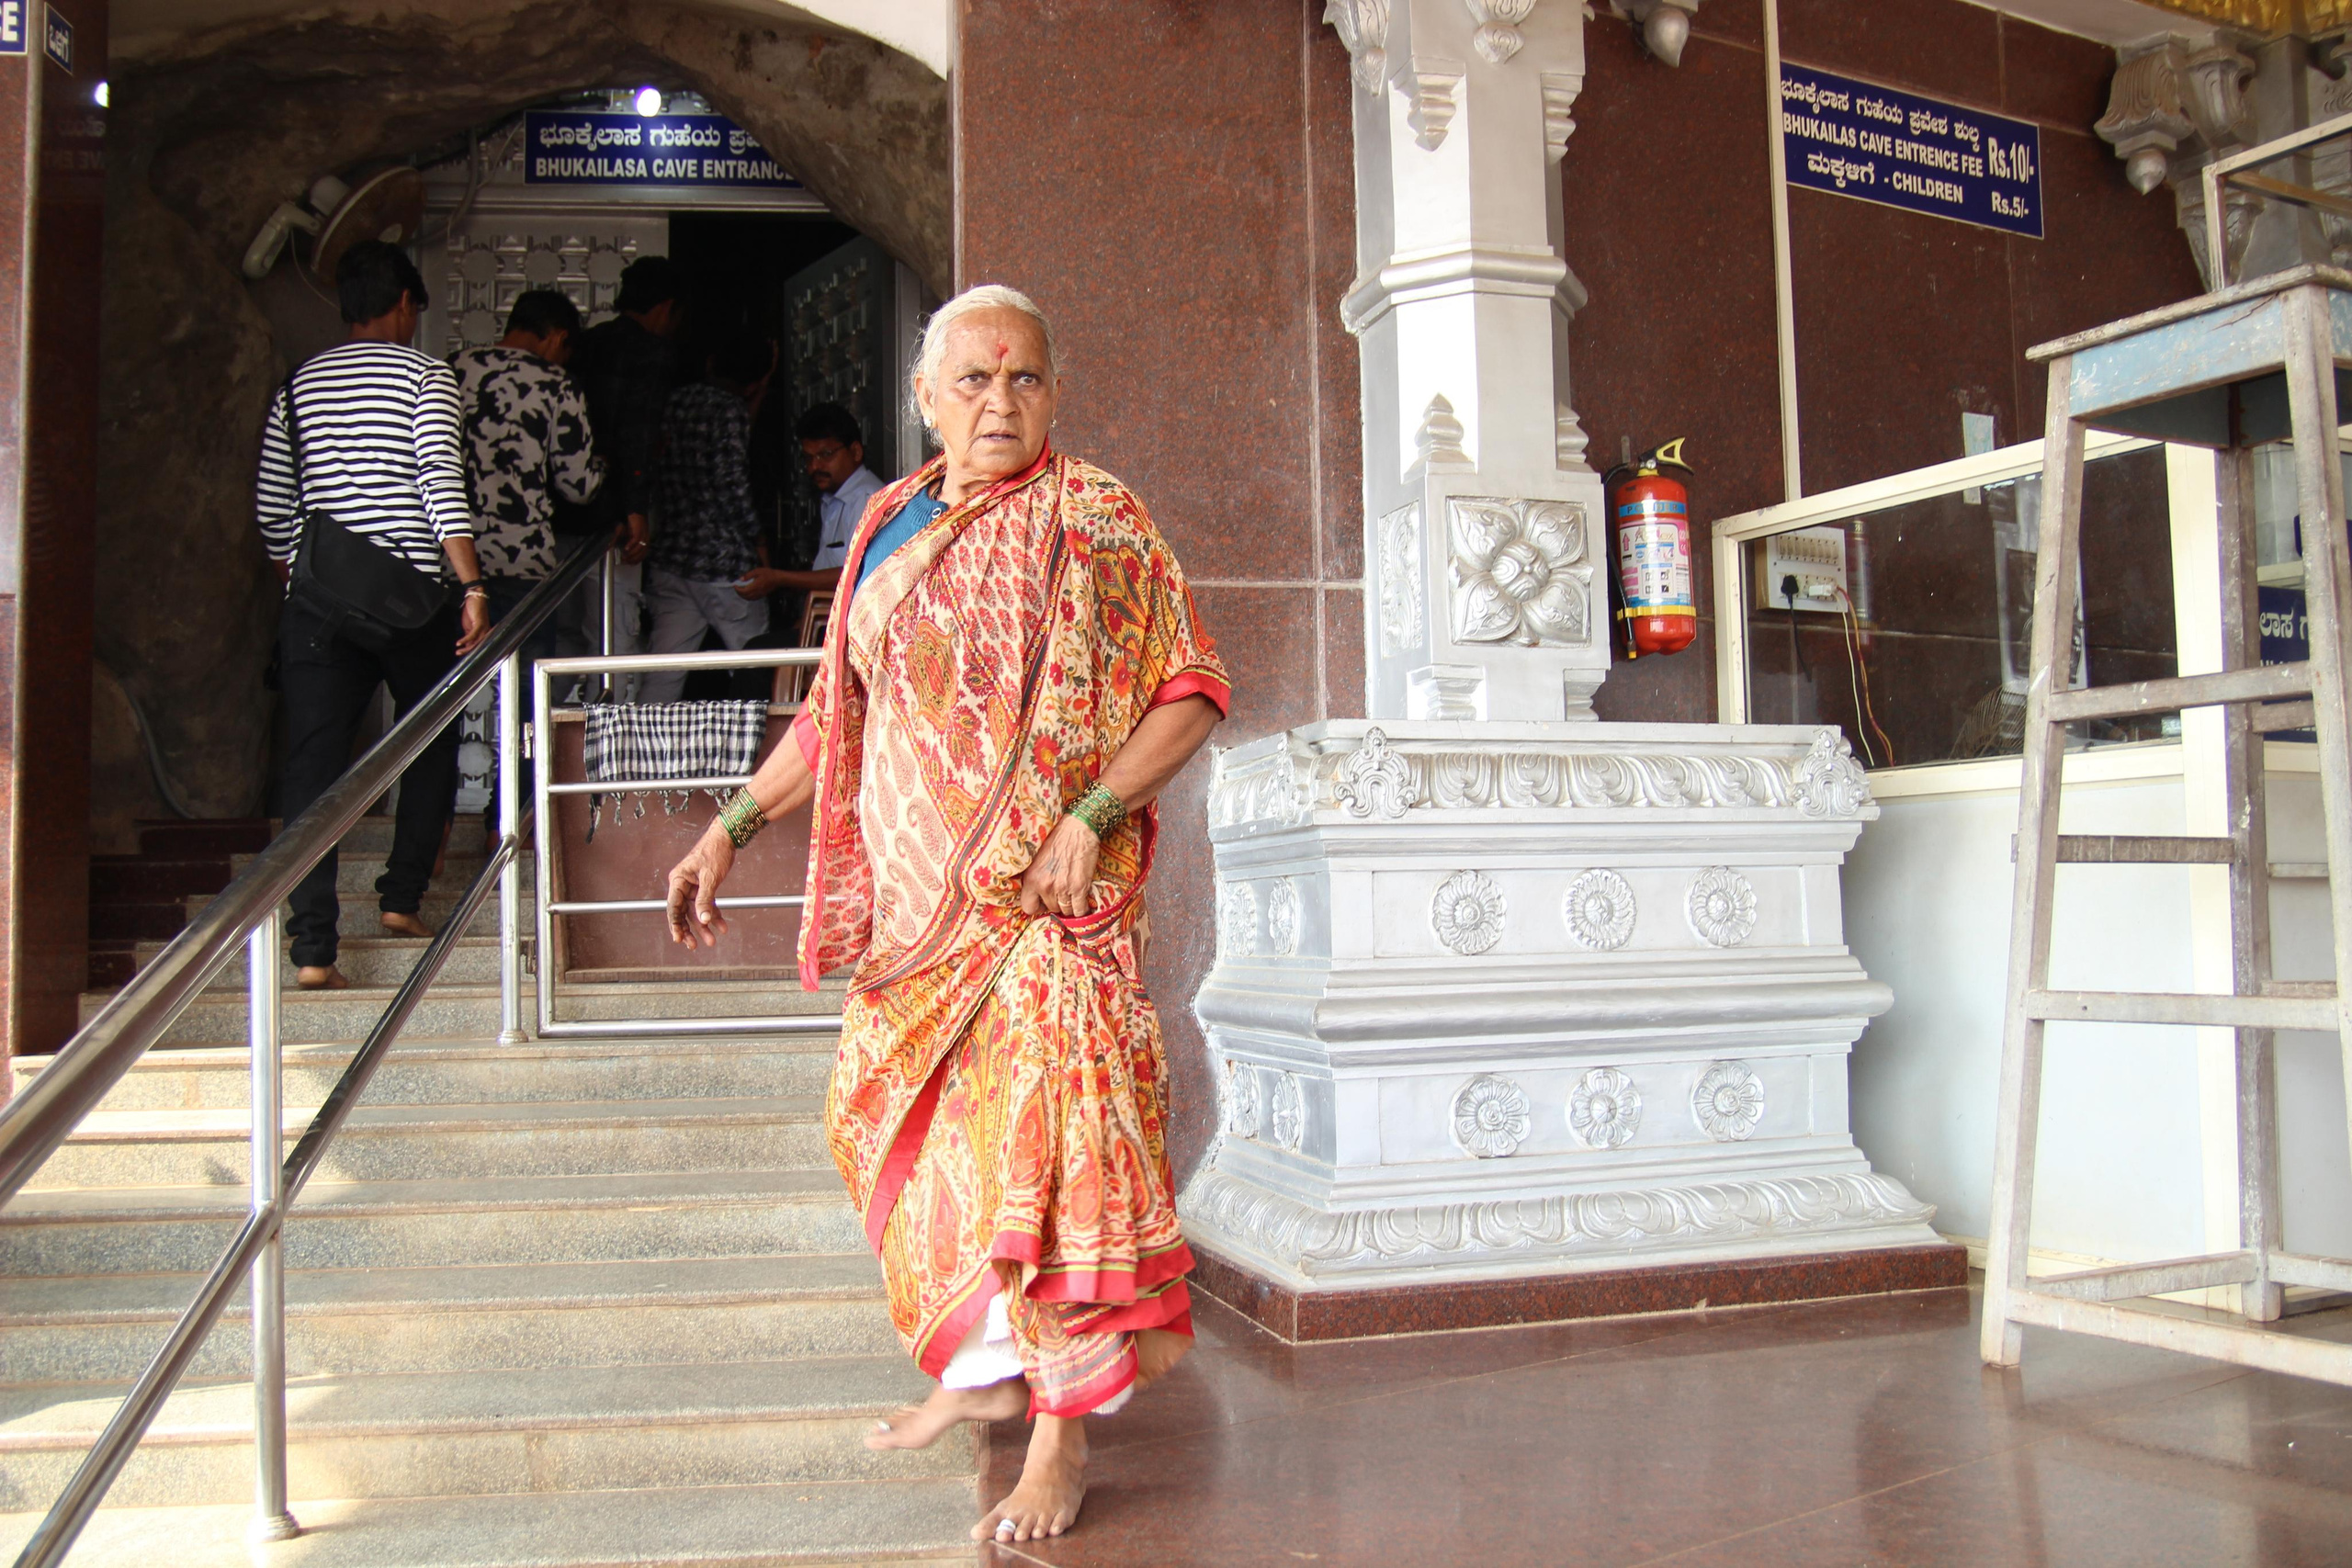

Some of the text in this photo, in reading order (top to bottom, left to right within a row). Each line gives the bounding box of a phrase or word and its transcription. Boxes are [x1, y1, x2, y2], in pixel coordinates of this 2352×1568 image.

[0, 1, 18, 41] E
[1781, 76, 1849, 114] ಭೂಕೈಲಾಸ
[1856, 95, 1903, 124] ಗುಹೆಯ
[1909, 109, 1948, 135] ಪ್ರವೇಶ
[539, 122, 641, 152] ಭೂಕೈಲಾಸ
[649, 123, 721, 147] ಗುಹೆಯ
[1783, 112, 1857, 149] BHUKAILAS
[1860, 130, 1893, 156] CAVE
[1895, 139, 1959, 173] ENTRENCE
[1962, 154, 1984, 178] FEE
[536, 157, 648, 178] BHUKAILASA
[651, 158, 698, 179] CAVE
[1892, 170, 1964, 204] CHILDREN
[1991, 190, 2030, 219] Rs.5/-
[2259, 608, 2294, 639] ಲಾಸ
